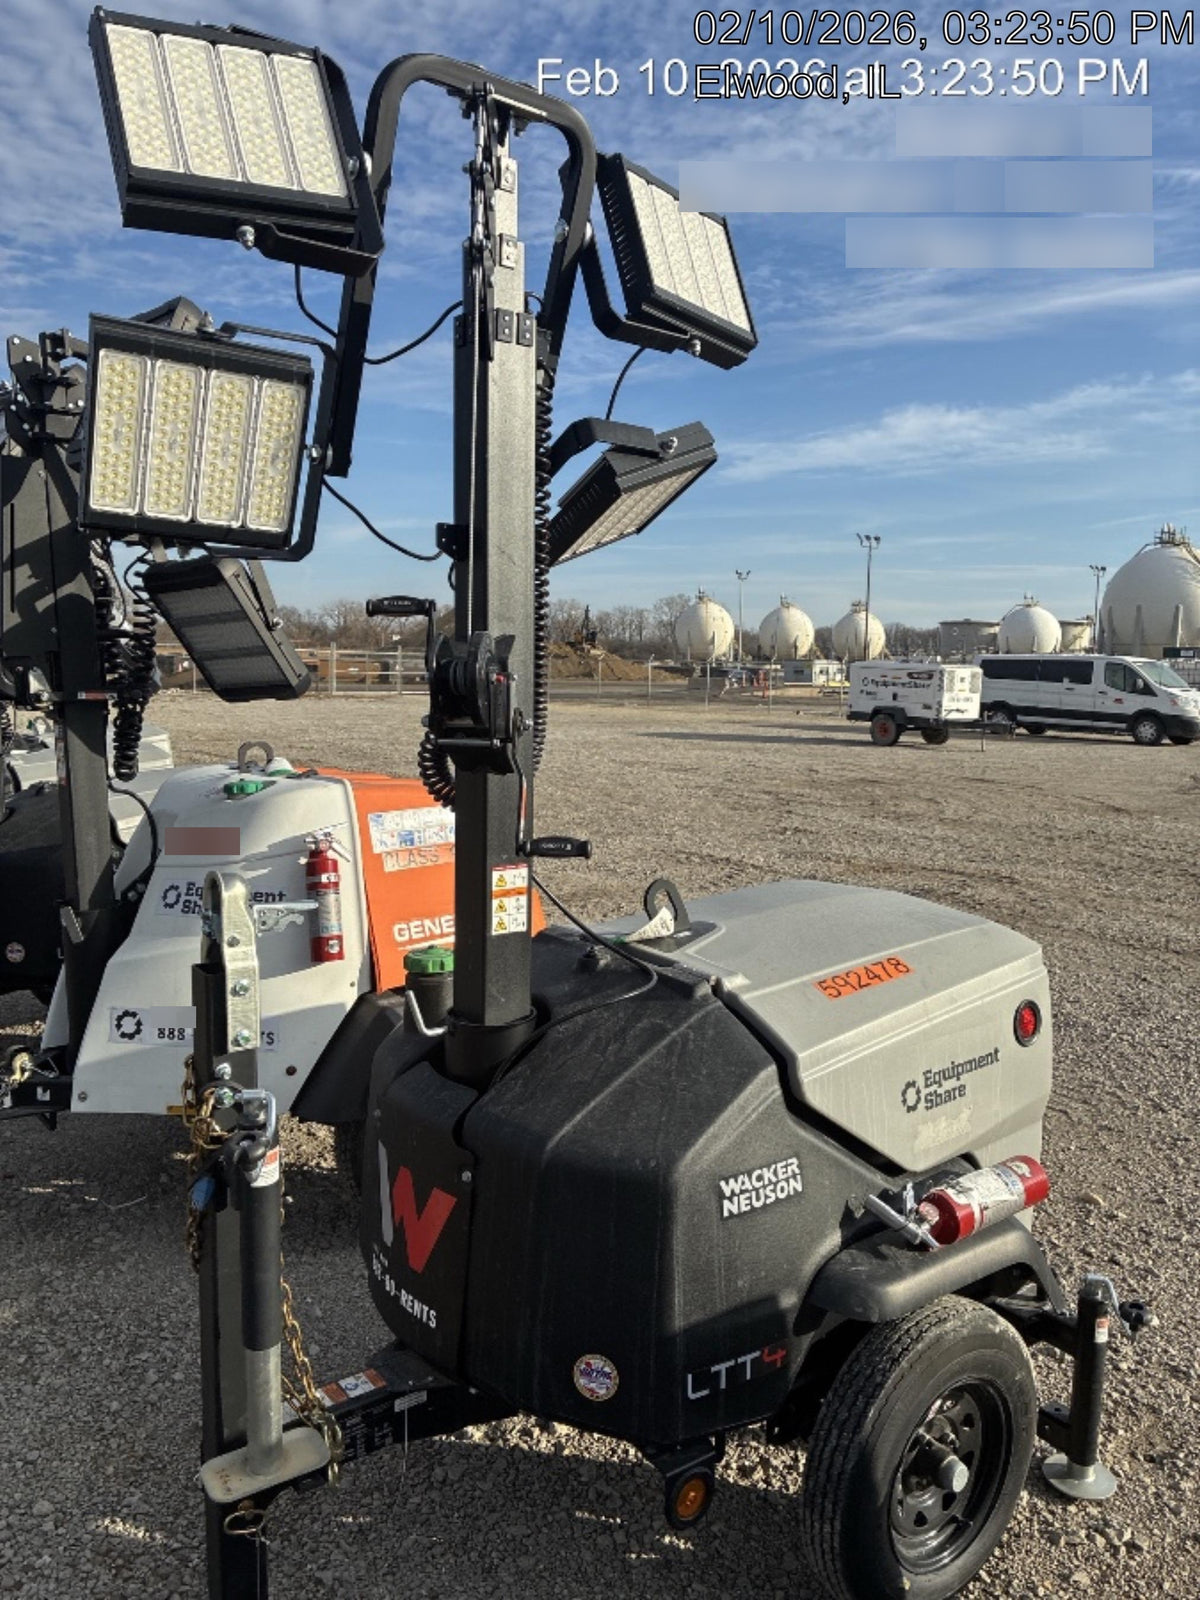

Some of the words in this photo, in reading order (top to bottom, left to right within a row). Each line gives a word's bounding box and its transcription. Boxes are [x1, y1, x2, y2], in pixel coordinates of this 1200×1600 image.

[393, 914, 456, 943] GENE
[817, 957, 910, 998] 592478
[922, 1047, 1000, 1089] Equipment
[924, 1084, 967, 1111] Share
[719, 1157, 801, 1198] WACKER
[722, 1174, 803, 1219] NEUSON
